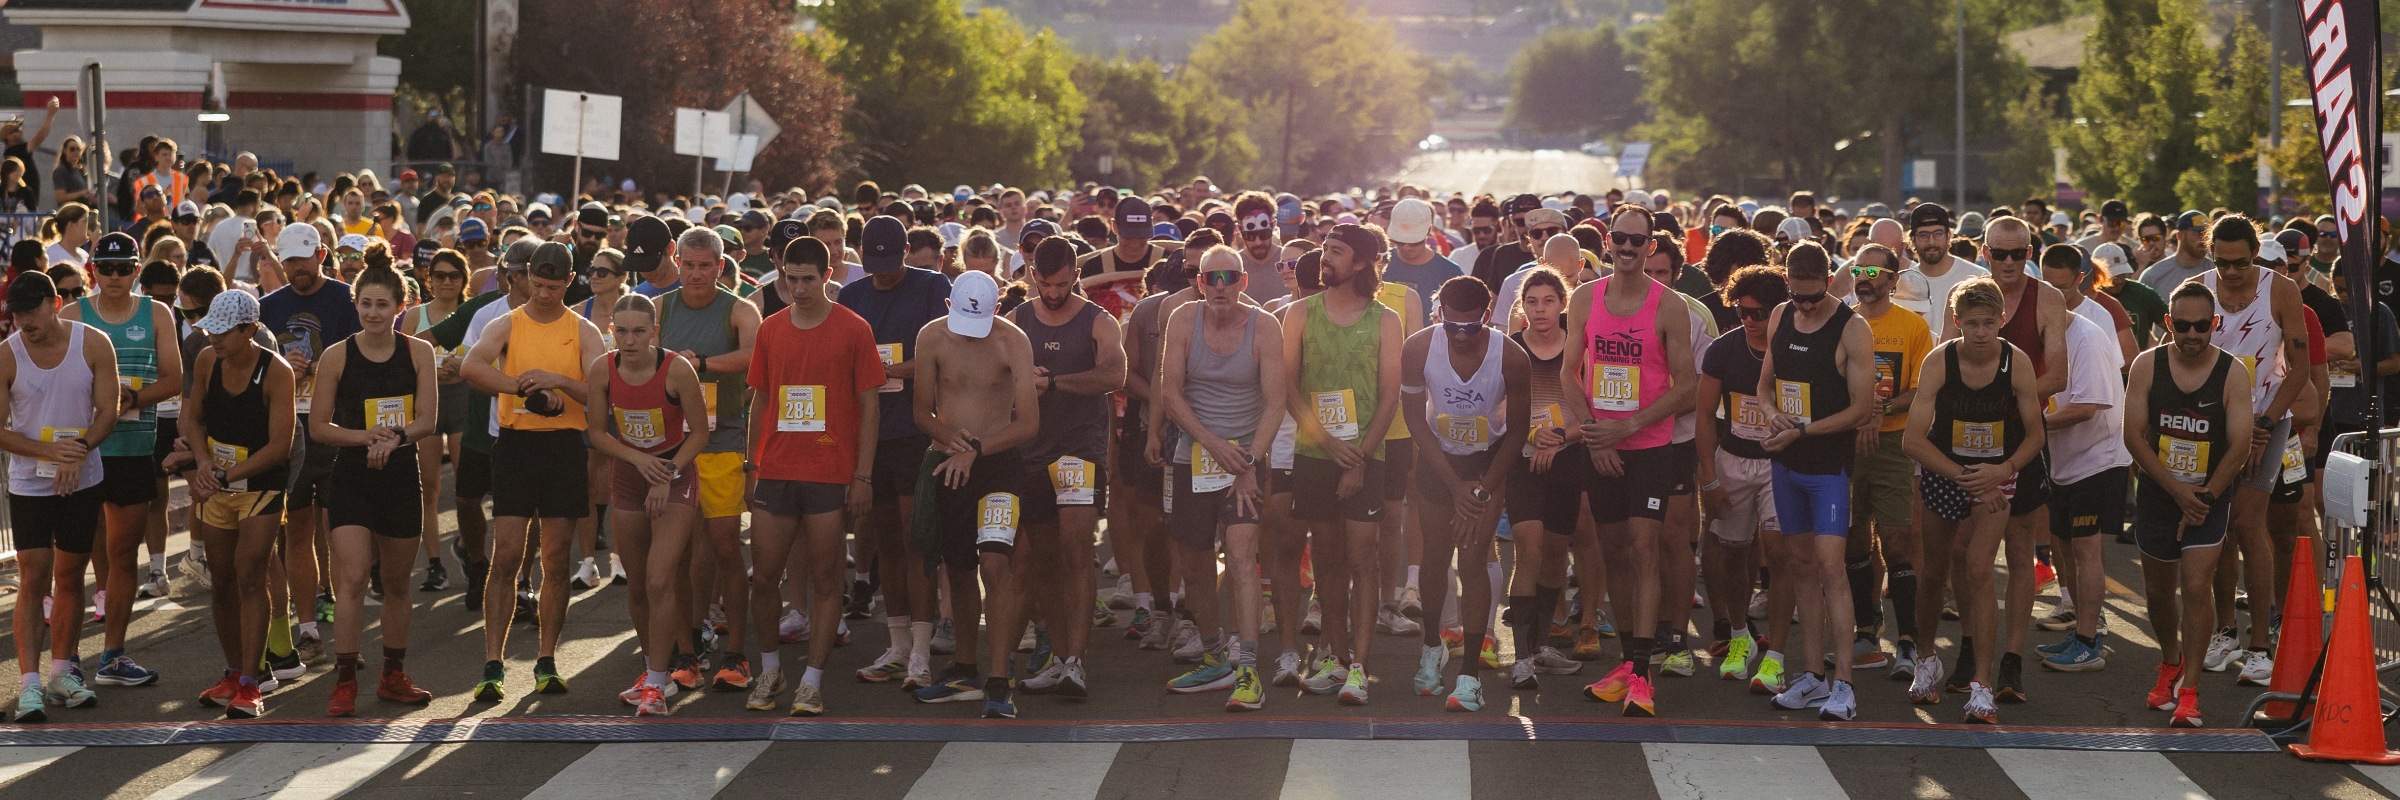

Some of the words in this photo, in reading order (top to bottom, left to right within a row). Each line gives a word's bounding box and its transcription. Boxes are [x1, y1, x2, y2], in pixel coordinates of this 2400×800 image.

[1595, 339, 1643, 357] RENO
[1596, 354, 1630, 364] RUNNING
[1599, 380, 1633, 399] 1013
[785, 401, 816, 419] 284
[1782, 396, 1803, 415] 880
[376, 411, 406, 428] 540
[1318, 406, 1347, 425] 528
[1739, 408, 1766, 426] 501
[2160, 413, 2209, 434] RENO
[624, 422, 655, 438] 283
[1448, 427, 1479, 442] 879
[1962, 434, 1994, 448] 349
[214, 456, 237, 468] 77
[1200, 456, 1226, 474] 32
[2166, 452, 2199, 472] 455
[1057, 470, 1085, 487] 984
[983, 507, 1013, 526] 985
[2072, 515, 2098, 527] NAVY
